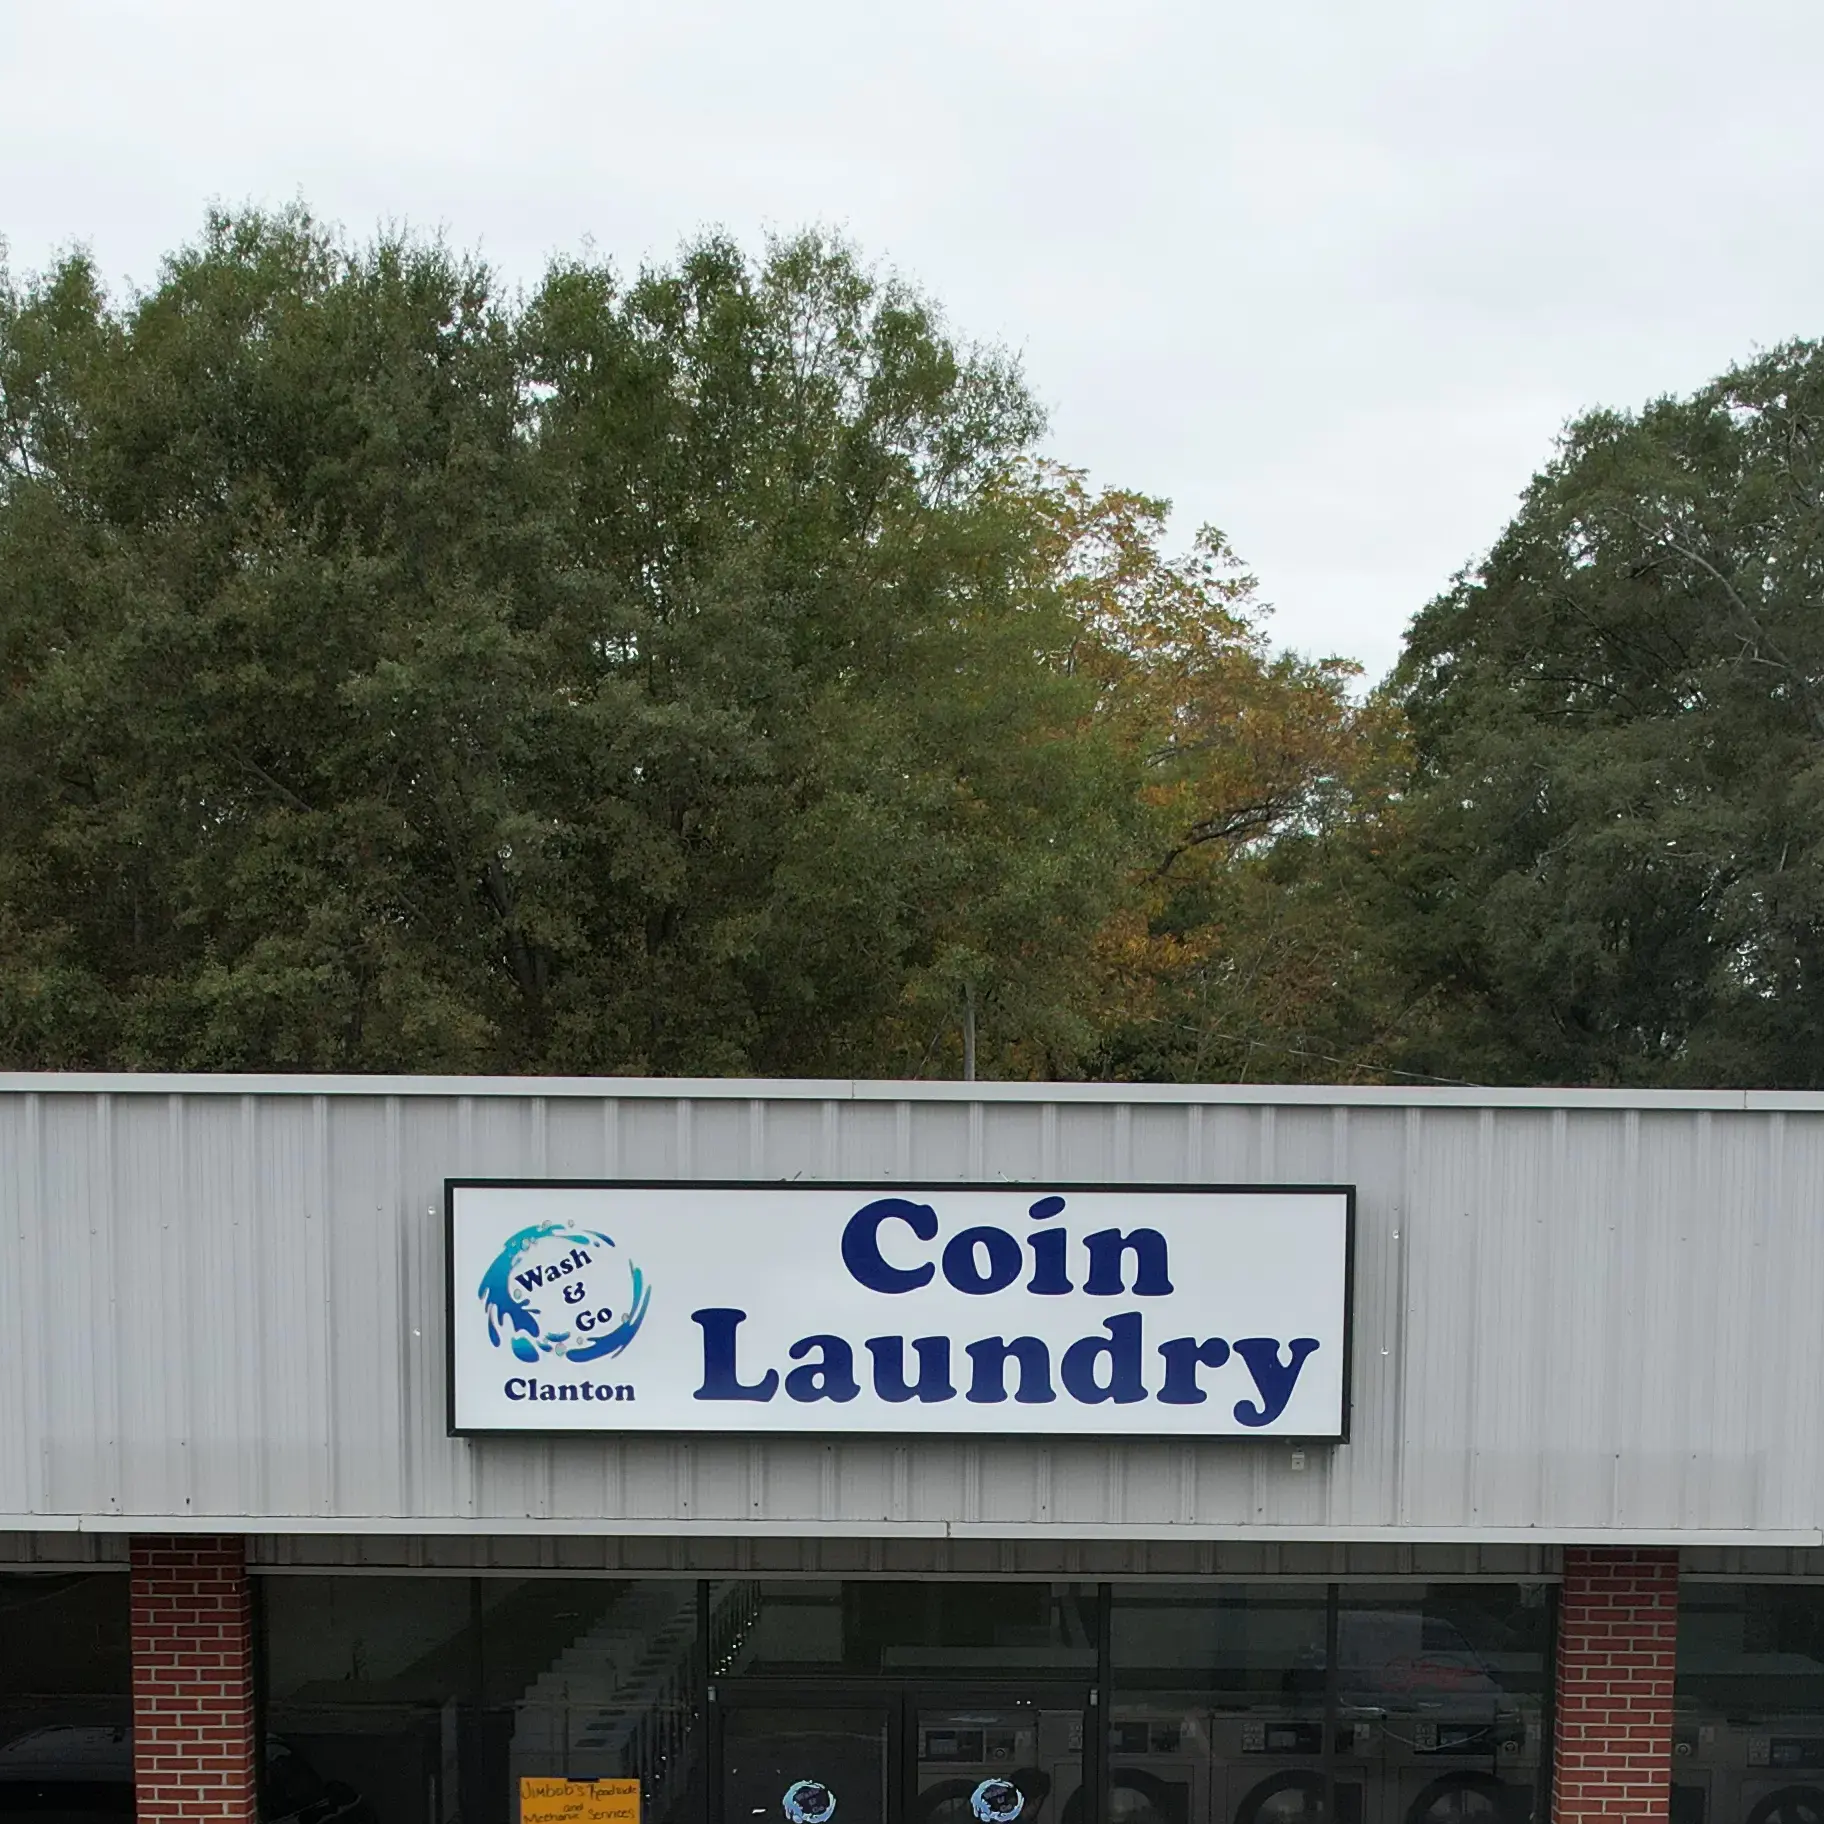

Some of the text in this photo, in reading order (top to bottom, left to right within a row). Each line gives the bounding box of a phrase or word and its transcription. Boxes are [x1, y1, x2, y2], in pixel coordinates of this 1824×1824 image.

[840, 1194, 1175, 1298] Coin
[514, 1248, 592, 1292] Wash
[563, 1281, 586, 1304] &
[575, 1307, 613, 1331] Go
[690, 1306, 1321, 1428] Laundry
[504, 1378, 636, 1401] Clanton
[563, 1803, 584, 1812] and
[588, 1808, 636, 1820] Services
